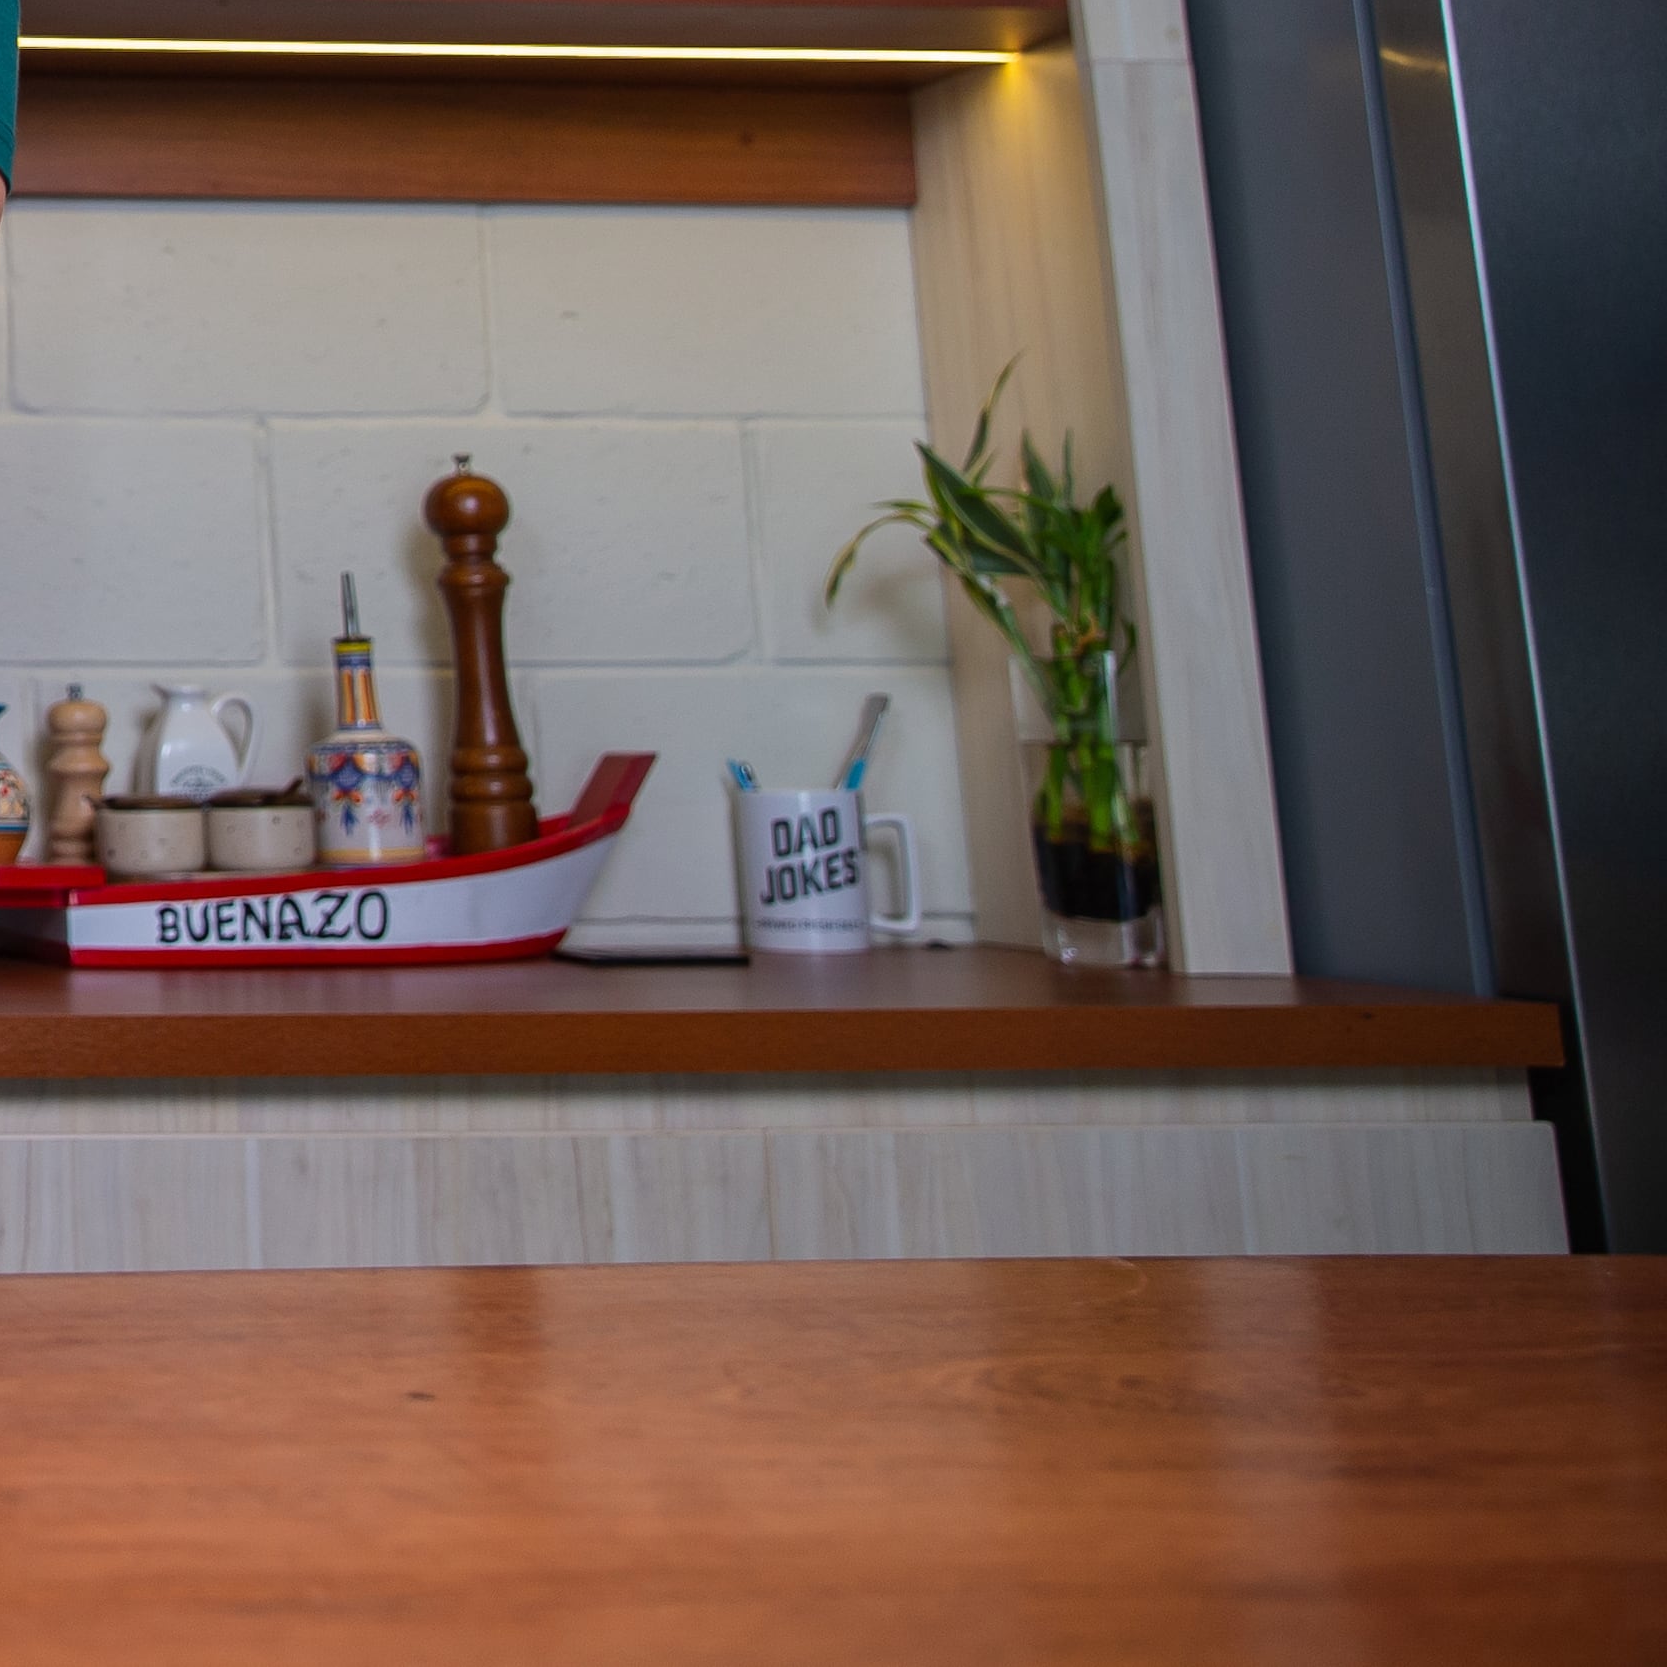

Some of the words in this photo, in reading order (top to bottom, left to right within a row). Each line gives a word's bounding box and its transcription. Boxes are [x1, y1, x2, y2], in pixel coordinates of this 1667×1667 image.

[770, 808, 840, 858] DAD
[760, 848, 858, 905] JOKES
[157, 889, 389, 944] BUENAZO
